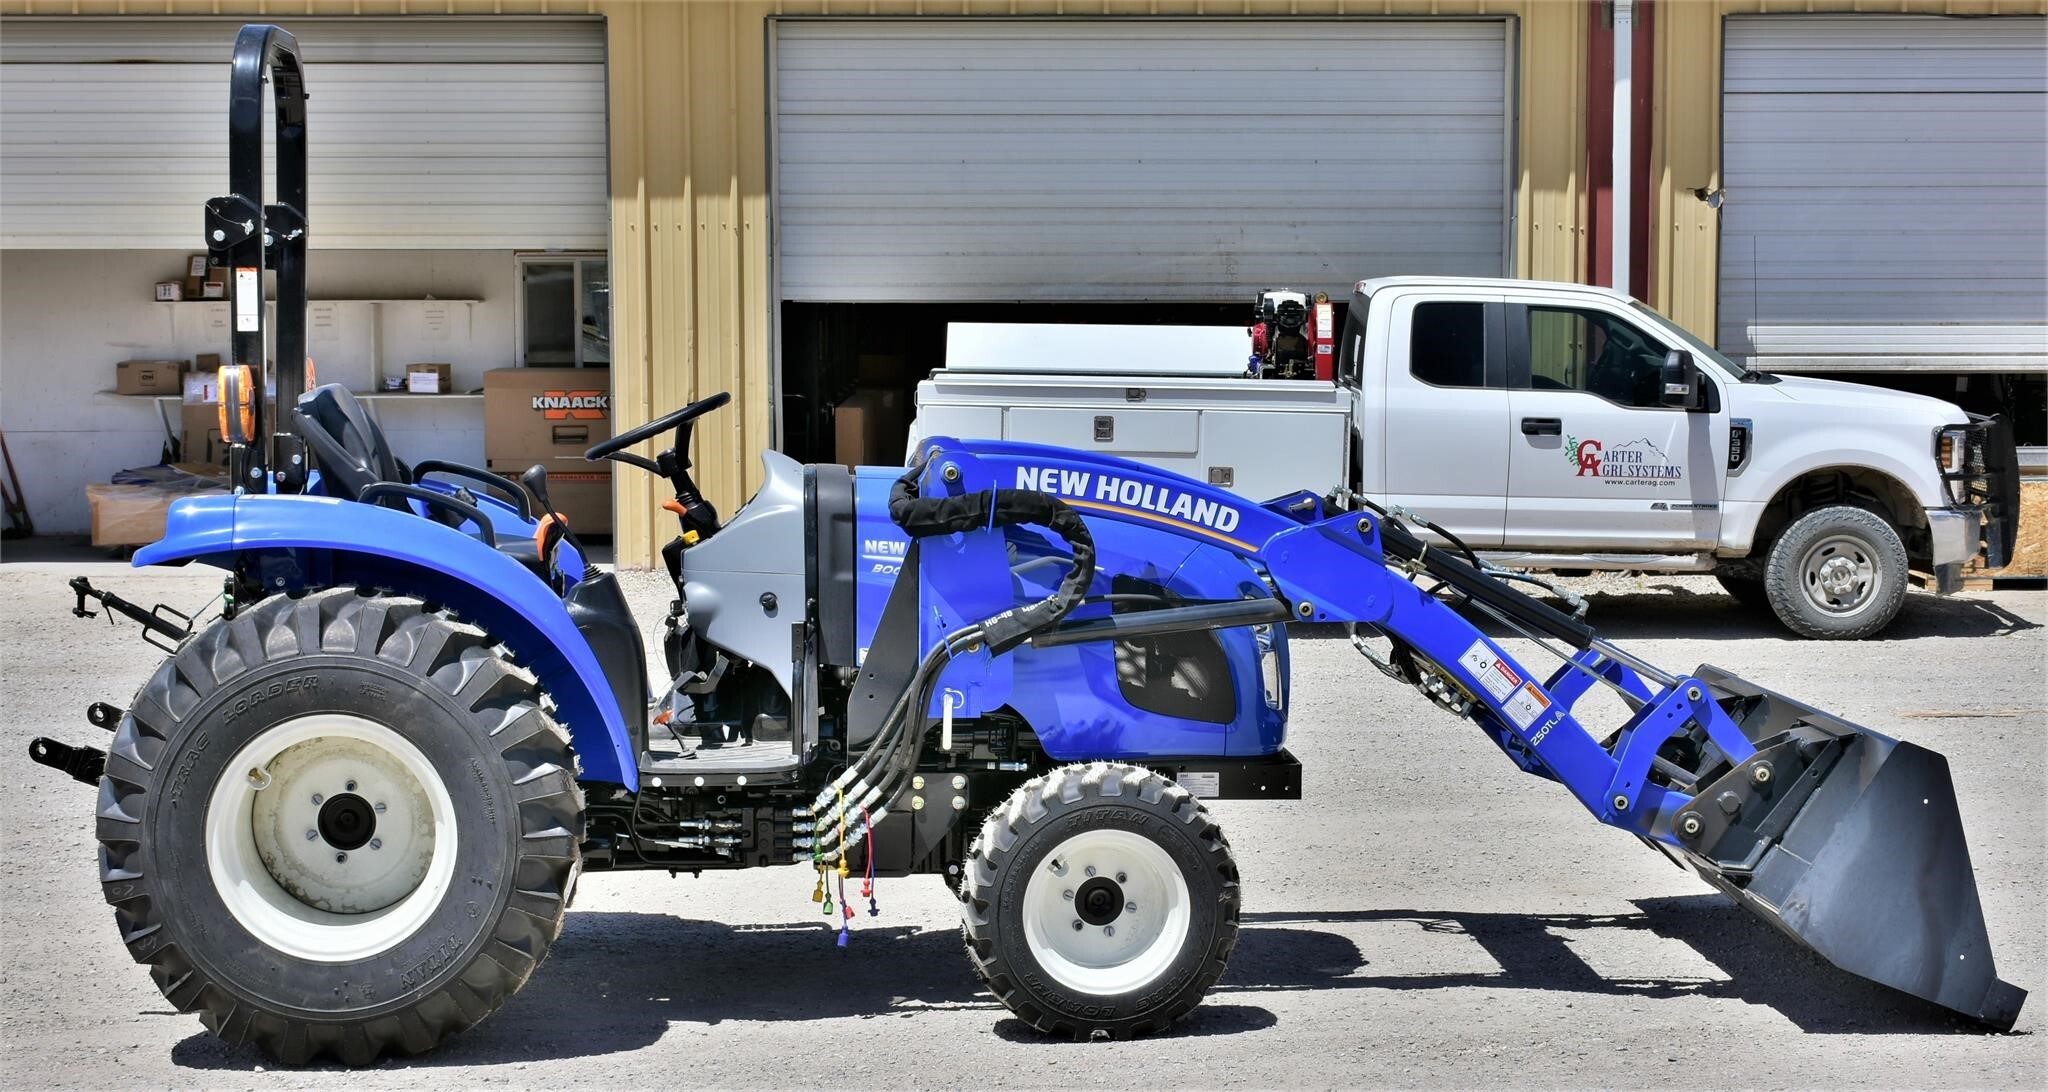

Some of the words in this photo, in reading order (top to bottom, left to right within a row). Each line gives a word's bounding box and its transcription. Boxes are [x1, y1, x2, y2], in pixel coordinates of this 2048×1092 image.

[532, 396, 607, 409] KNAACK
[1576, 454, 1681, 479] AGRI-SYSTEMS
[1577, 440, 1642, 468] CARTER
[1605, 479, 1675, 487] www.carterag.com
[1016, 466, 1090, 497] NEW
[1096, 475, 1240, 533] HOLLAND
[864, 540, 906, 555] NEW
[222, 675, 319, 725] LOADER
[1067, 808, 1149, 826] TITAN
[400, 933, 463, 990] TITAN
